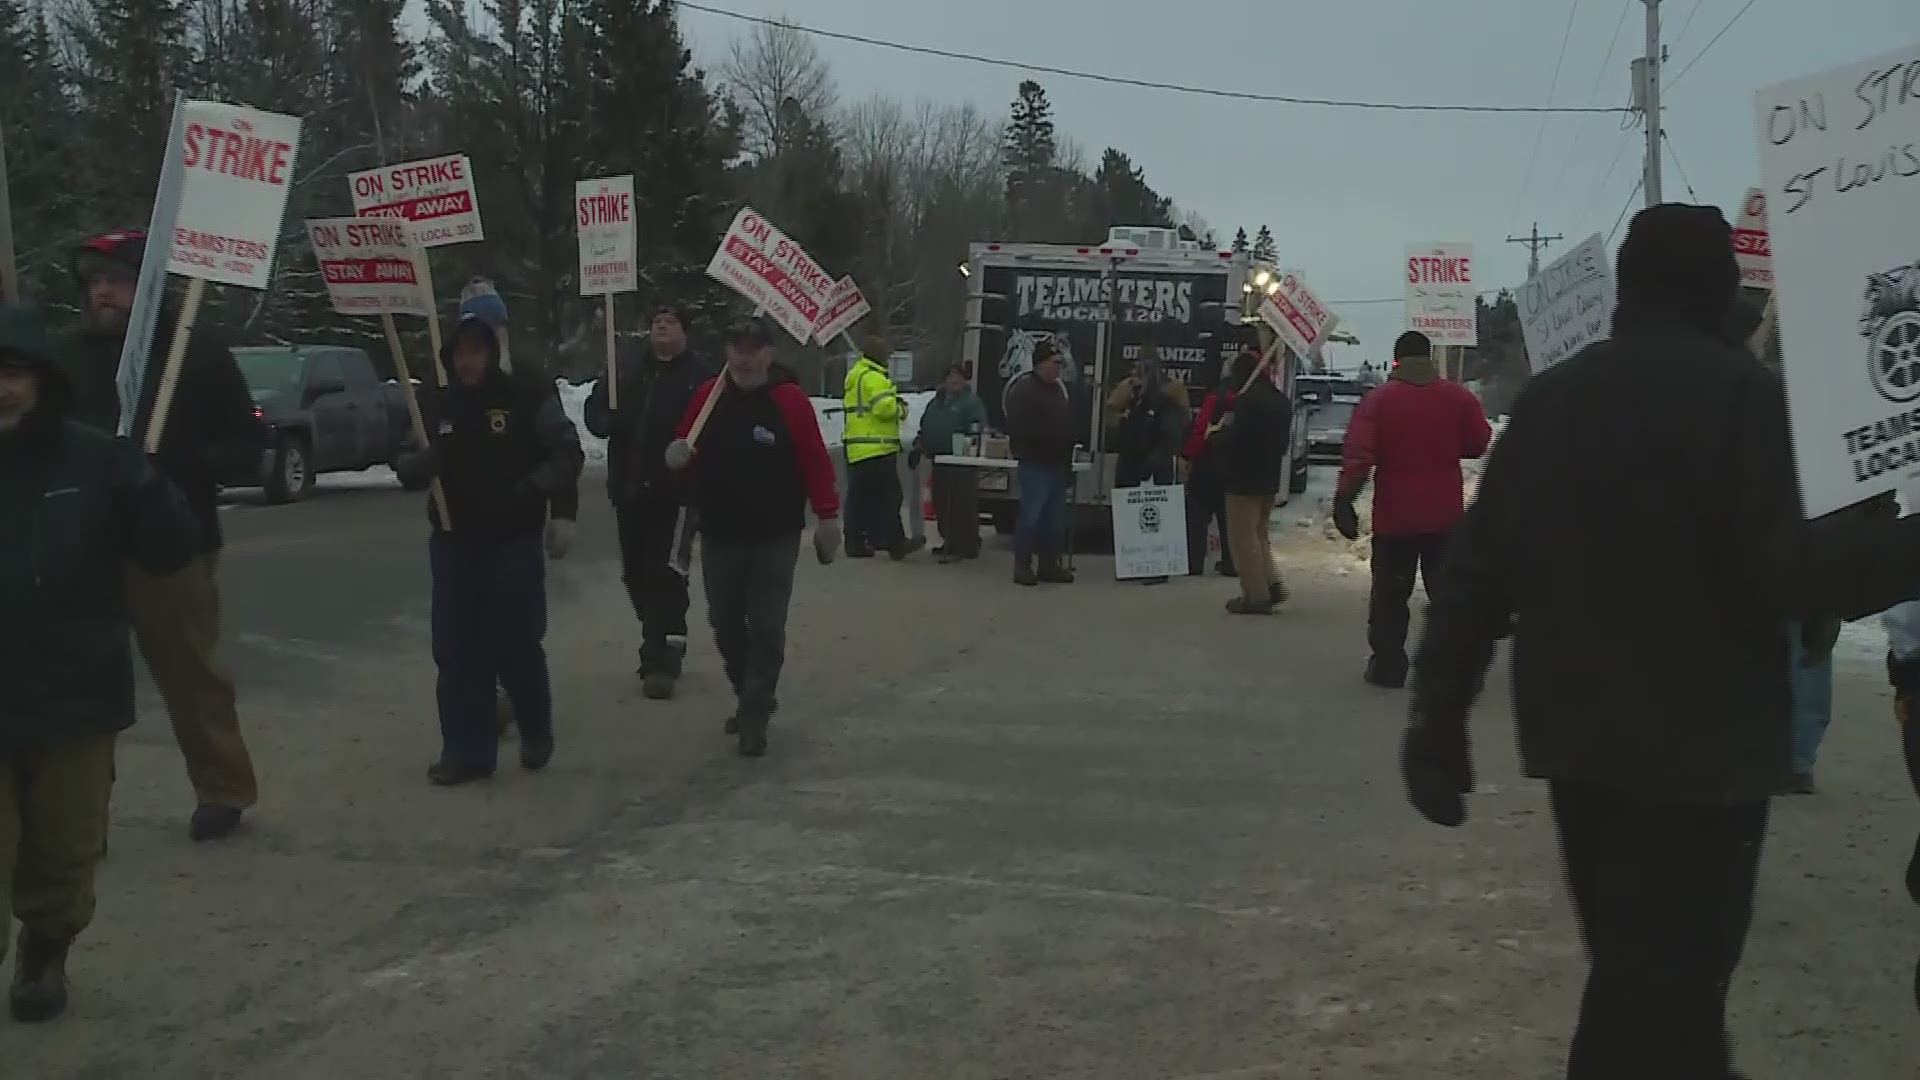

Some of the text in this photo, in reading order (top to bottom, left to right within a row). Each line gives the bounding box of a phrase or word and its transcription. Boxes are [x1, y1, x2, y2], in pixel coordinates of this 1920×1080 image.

[1768, 90, 1827, 145] ON
[183, 122, 292, 186] STRIKE
[355, 174, 384, 198] ON
[391, 159, 465, 191] STRIKE
[414, 193, 467, 217] AWAY
[579, 192, 630, 226] STRIKE
[174, 227, 270, 261] EAMSTERS
[313, 225, 342, 249] ON
[348, 224, 406, 249] STRIKE
[421, 227, 454, 244] LOCAL
[325, 263, 367, 281] STAY
[741, 213, 834, 297] ON STRIKE
[1408, 257, 1471, 283] STRIKE
[776, 278, 817, 316] AWAY
[1016, 275, 1193, 325] TEAMSTERS
[1041, 305, 1116, 323] LOCAL
[1412, 317, 1473, 330] TEAMSTERS
